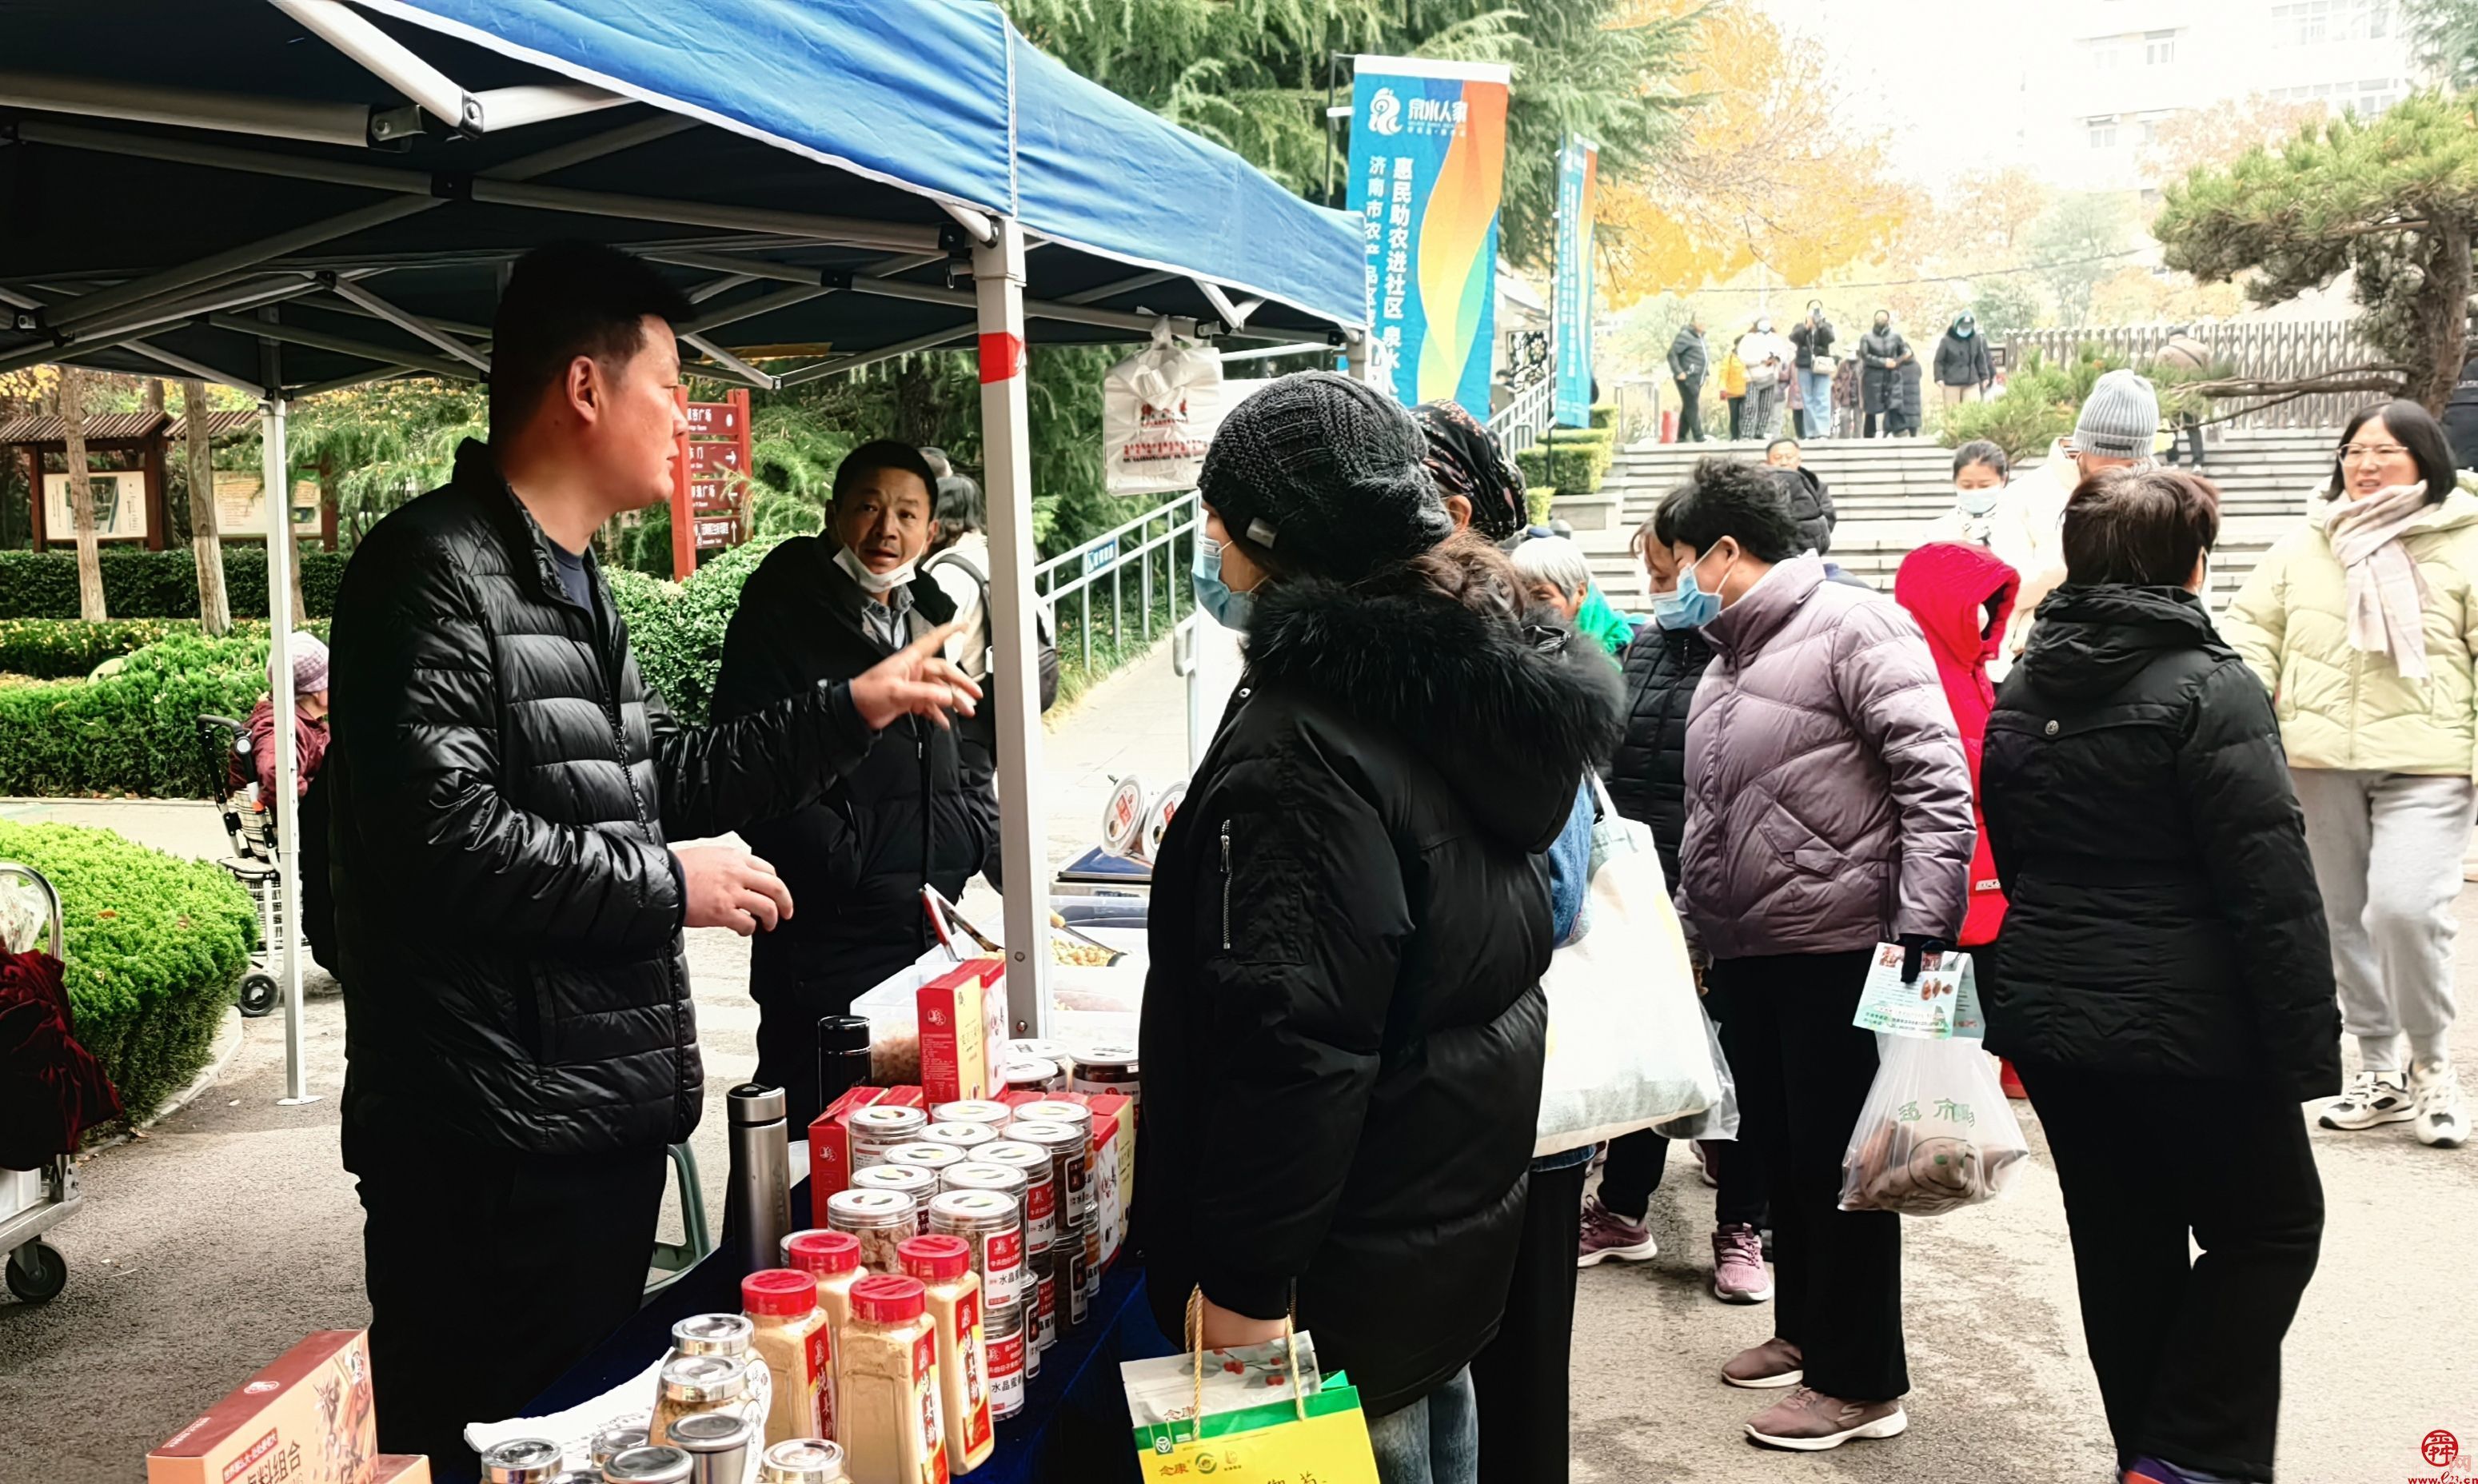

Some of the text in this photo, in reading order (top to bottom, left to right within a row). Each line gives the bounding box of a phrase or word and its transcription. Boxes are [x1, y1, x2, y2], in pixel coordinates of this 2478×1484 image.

[1408, 98, 1468, 123] 泉水人家
[1383, 157, 1414, 319] 惠民助农进社区
